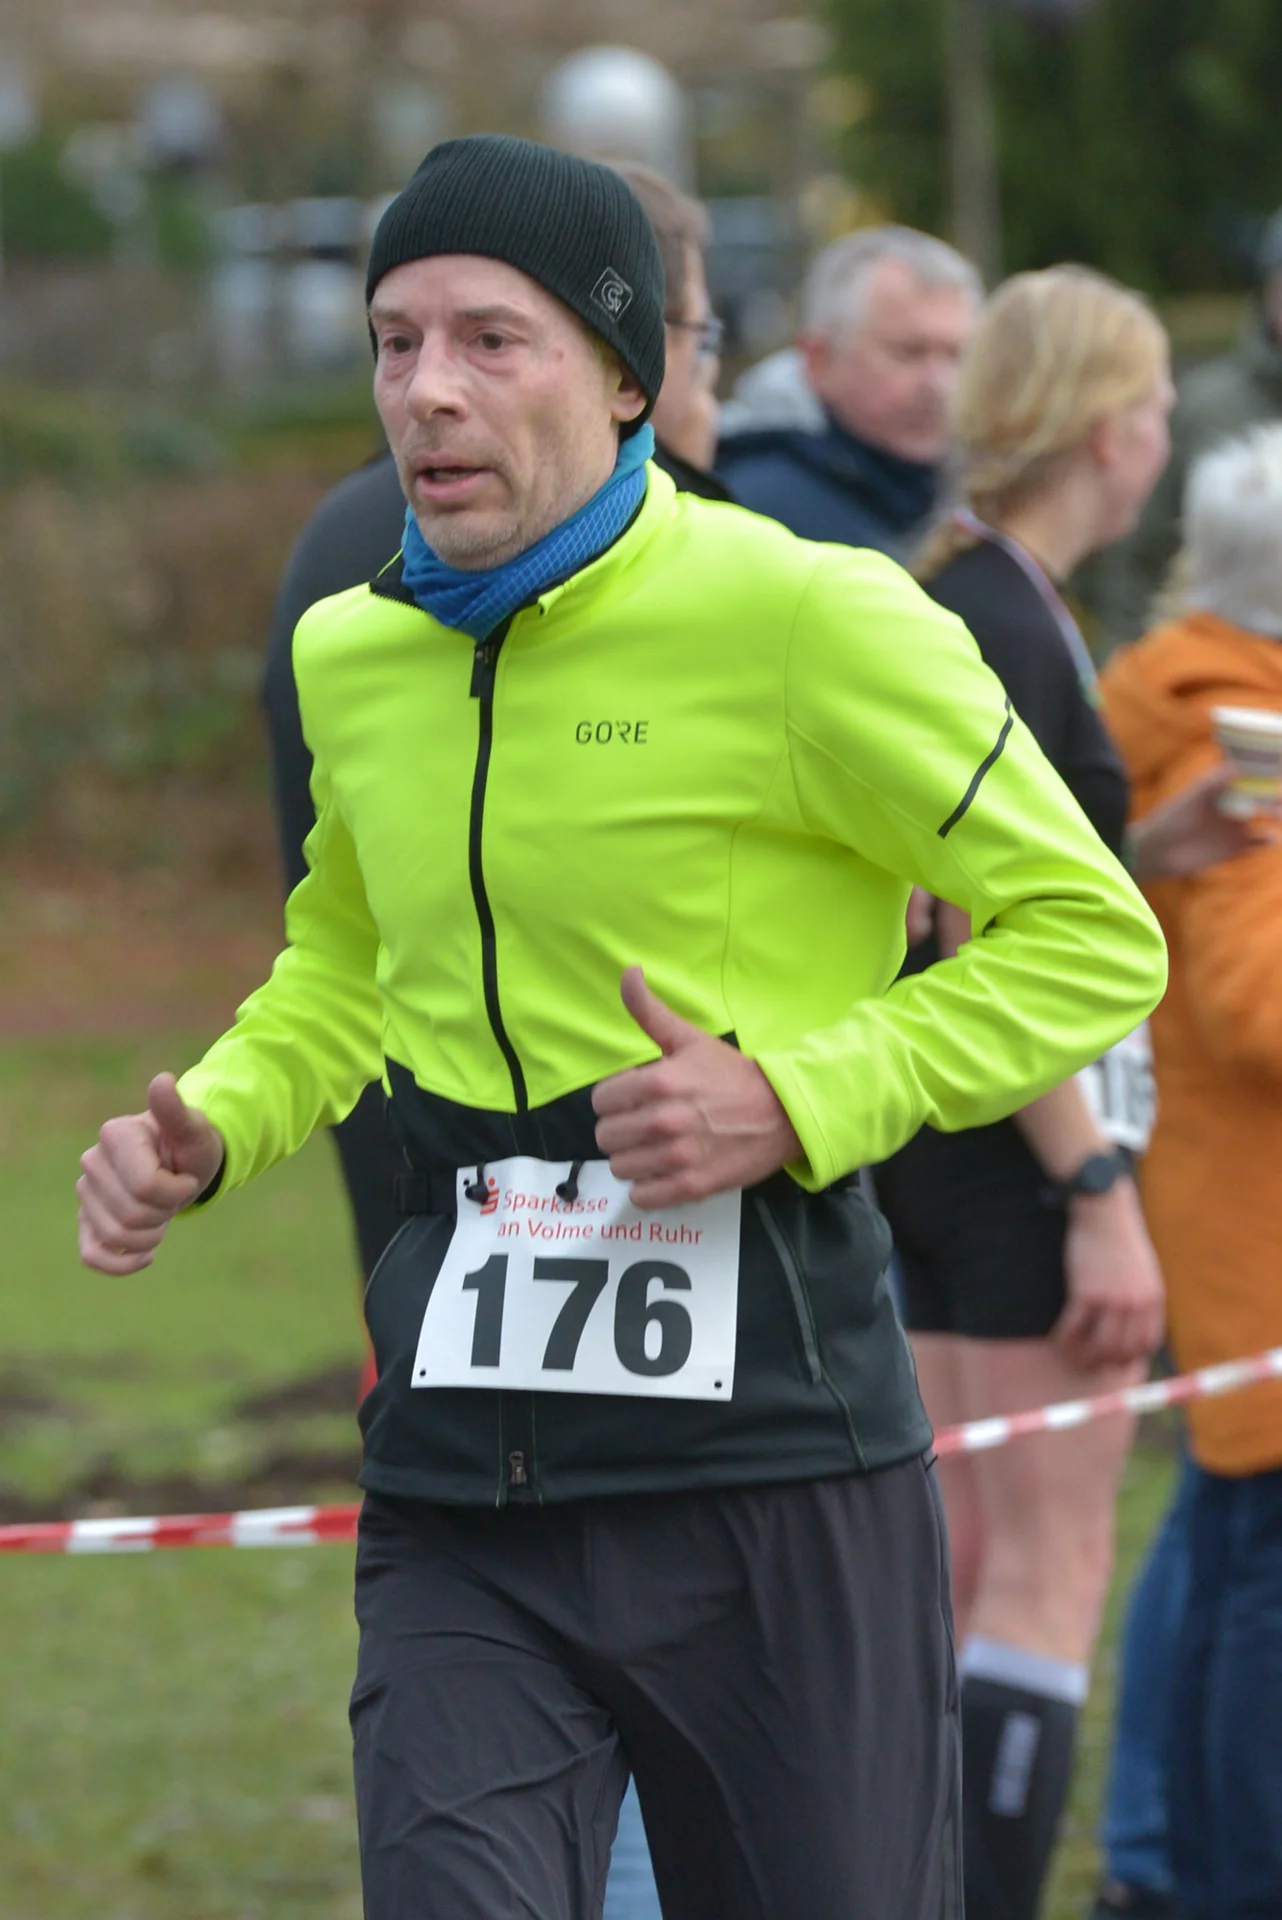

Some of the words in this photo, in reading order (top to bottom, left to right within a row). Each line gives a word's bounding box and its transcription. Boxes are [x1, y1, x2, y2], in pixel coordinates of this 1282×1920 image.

[575, 720, 649, 744] GORE
[502, 1188, 609, 1214] Sparkasse
[497, 1220, 520, 1238] an
[527, 1219, 594, 1240] Volme
[600, 1222, 642, 1241] und
[649, 1223, 704, 1245] Ruhr
[461, 1253, 693, 1377] 176
